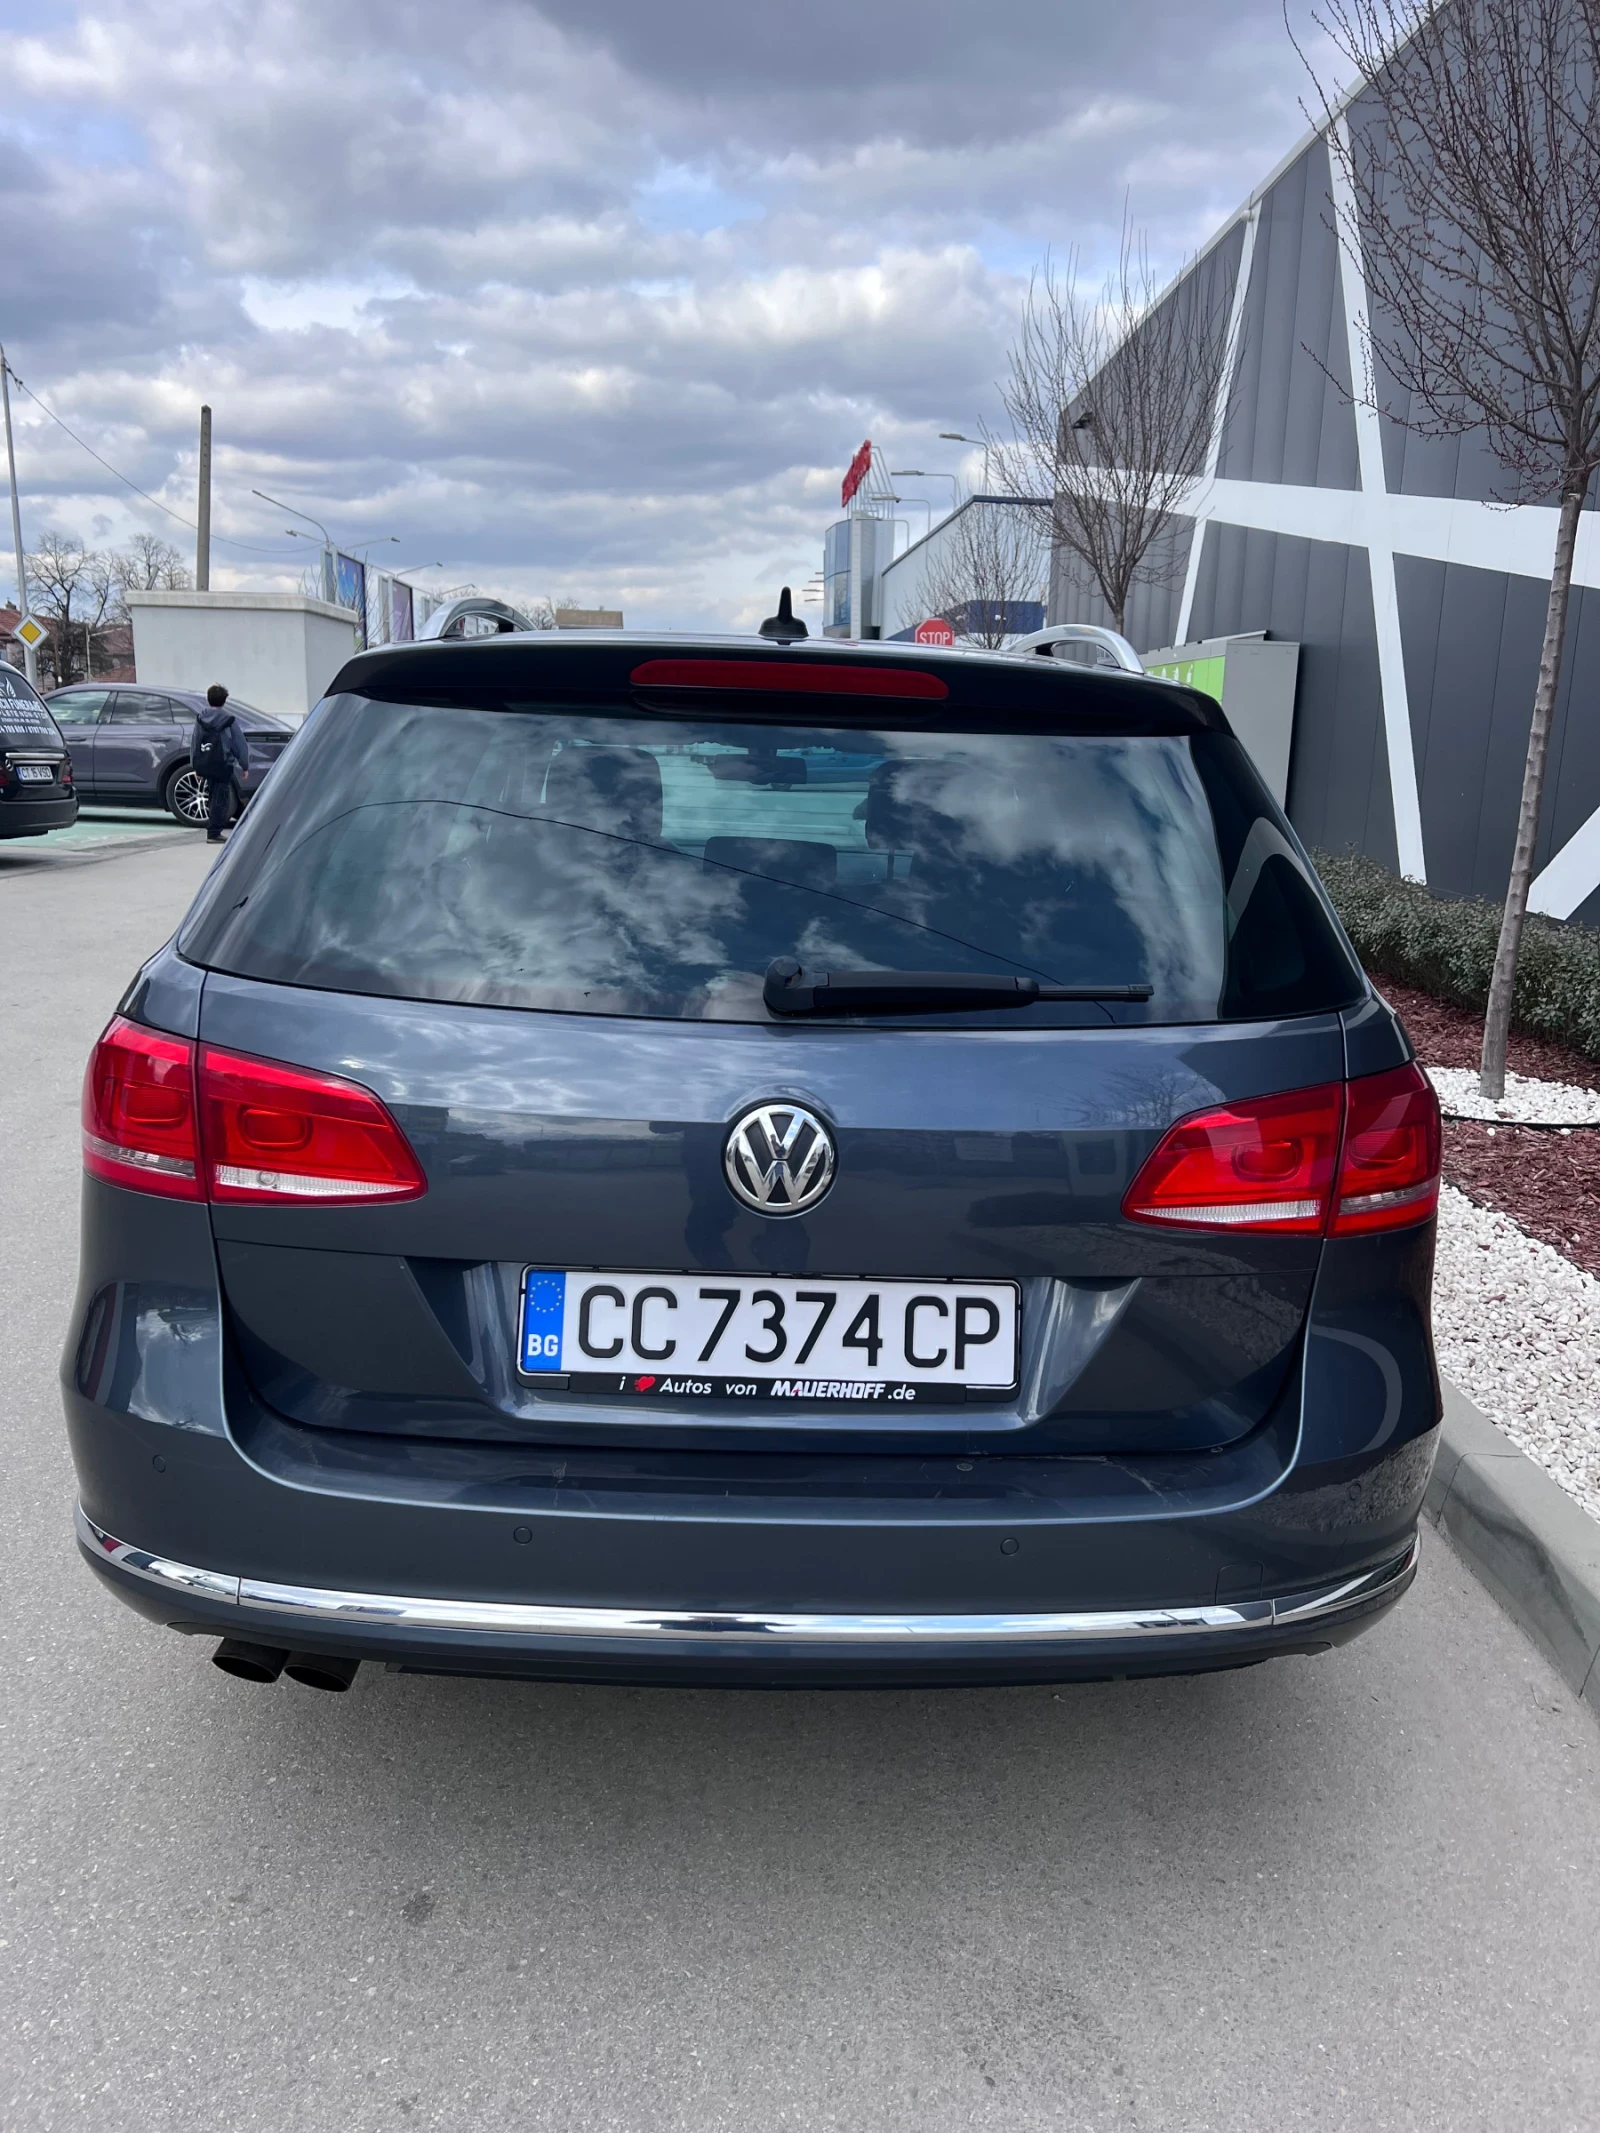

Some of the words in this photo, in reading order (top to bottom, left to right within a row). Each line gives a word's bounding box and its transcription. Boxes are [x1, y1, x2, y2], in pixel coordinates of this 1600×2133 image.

[919, 631, 951, 645] STOP
[578, 1284, 678, 1361] CC
[697, 1287, 883, 1368] 7374
[903, 1295, 1001, 1371] CP
[527, 1333, 559, 1357] BG
[619, 1375, 626, 1391] i
[659, 1377, 712, 1395] Autos
[725, 1382, 757, 1396] von
